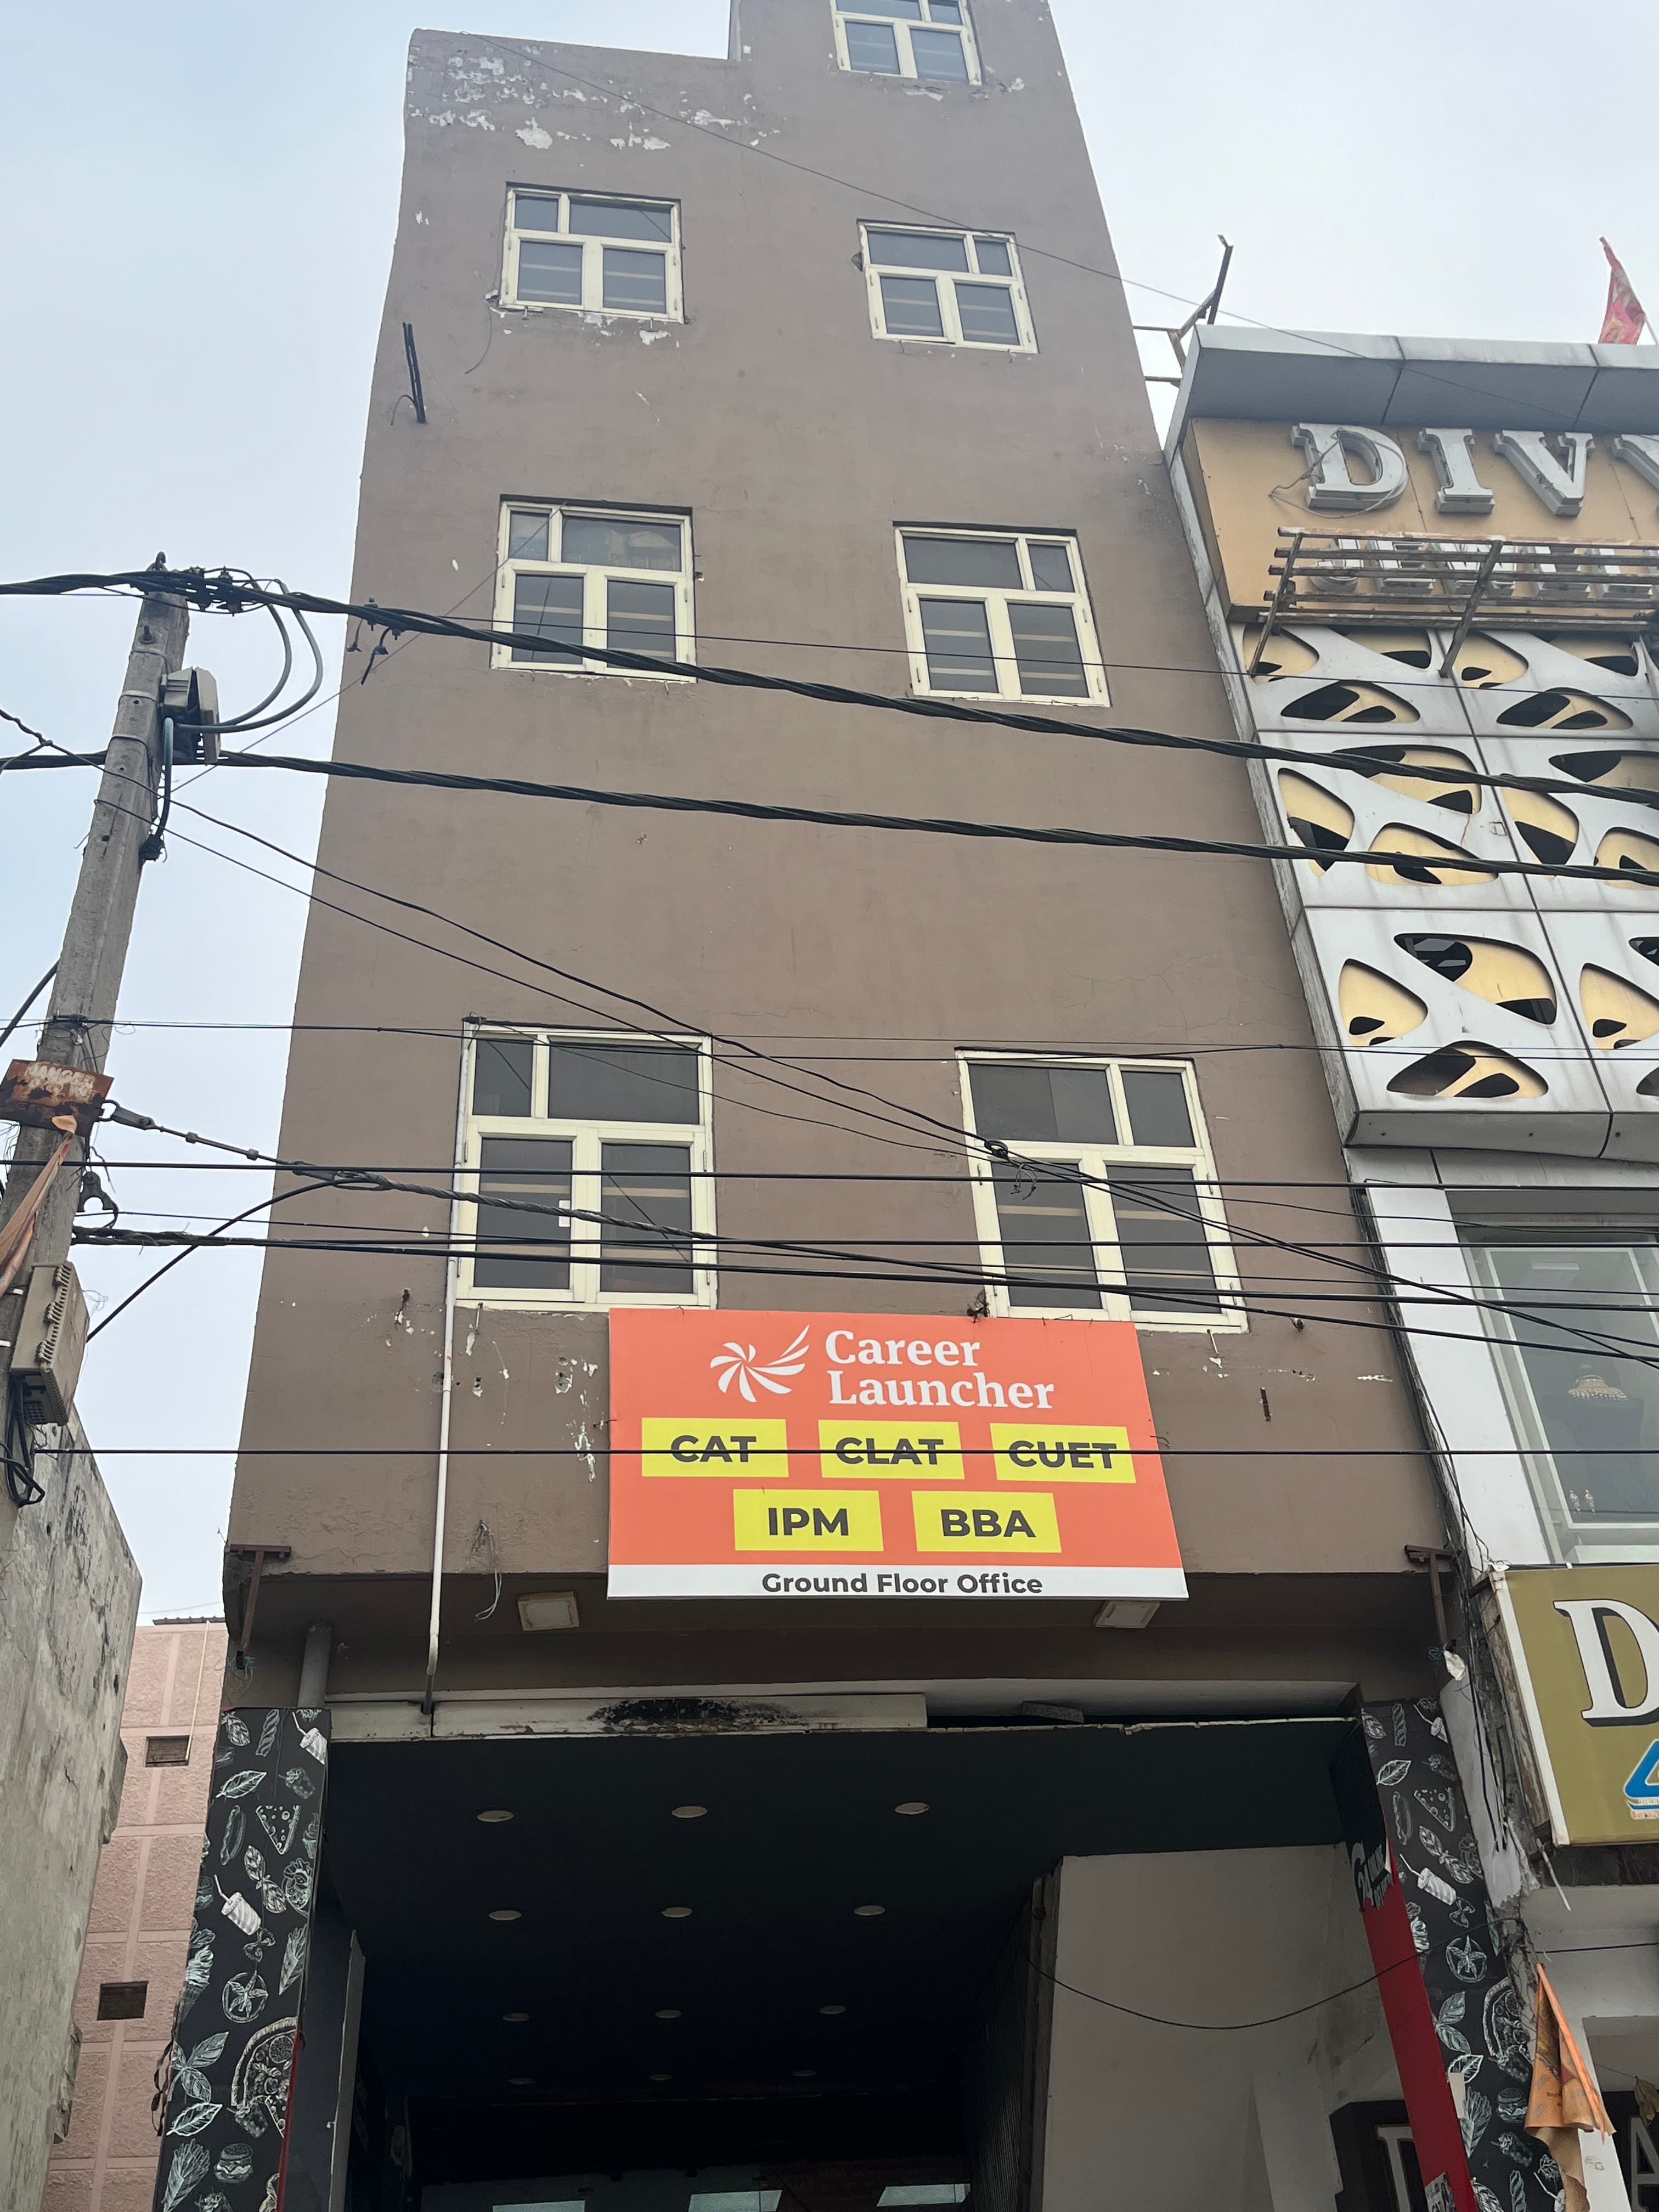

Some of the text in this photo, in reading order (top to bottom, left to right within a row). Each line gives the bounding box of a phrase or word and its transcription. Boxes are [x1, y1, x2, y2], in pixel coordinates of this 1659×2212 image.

[826, 1330, 980, 1366] Career
[827, 1370, 1054, 1409] Launcher
[671, 1435, 757, 1463] CAT
[836, 1437, 944, 1465] CLAT
[1009, 1441, 1118, 1469] CUET
[768, 1508, 849, 1536] IPM
[941, 1509, 1036, 1538] BBA
[763, 1572, 1043, 1594] Ground Floor Office
